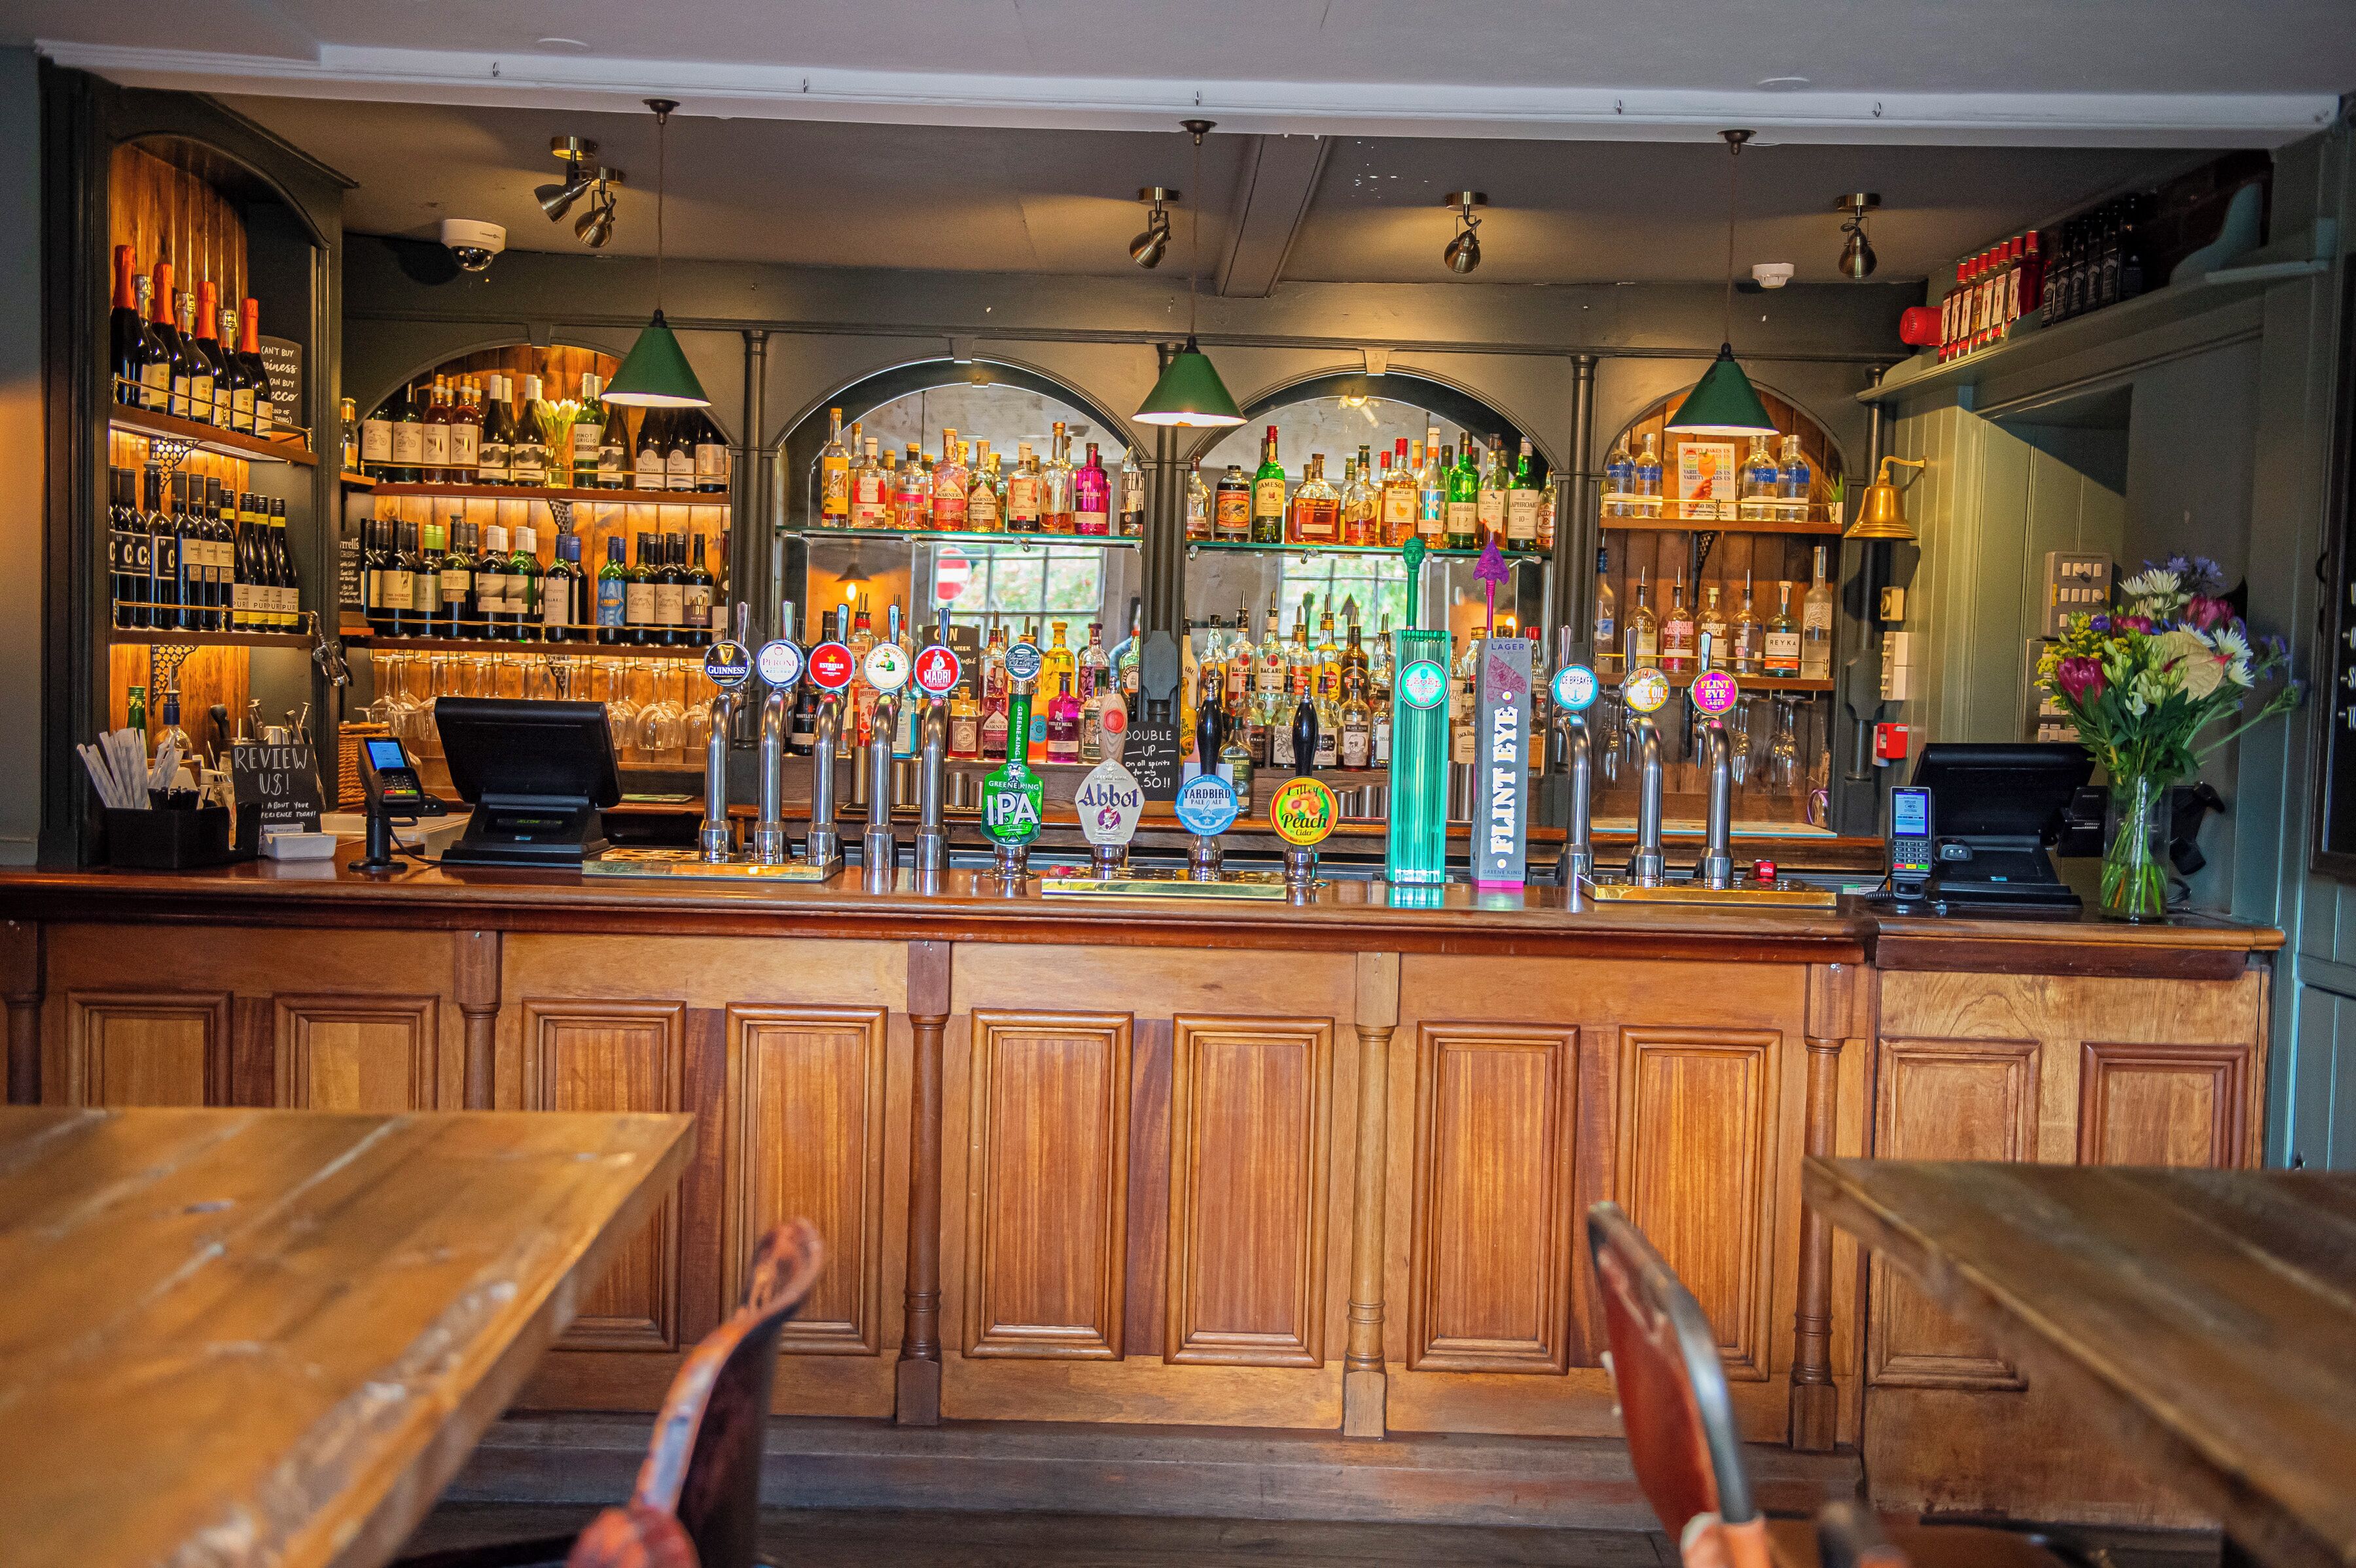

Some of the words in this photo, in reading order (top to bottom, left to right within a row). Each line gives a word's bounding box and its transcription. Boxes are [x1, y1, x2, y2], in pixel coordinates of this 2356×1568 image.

[261, 346, 279, 355] CAN'T
[707, 666, 746, 674] GUINNESS
[1406, 677, 1442, 688] LEVEL
[1569, 676, 1593, 685] BREAKER
[1701, 680, 1730, 689] FLINT
[1652, 687, 1664, 698] OIL
[1705, 689, 1726, 698] EYE
[1493, 706, 1518, 762] EYE
[1142, 745, 1156, 757] UP
[235, 747, 308, 772] REVIEW
[1149, 760, 1170, 769] spirits
[260, 774, 289, 795] US!
[1078, 783, 1139, 808] Abbot
[1184, 789, 1230, 799] YARDBIRD
[987, 793, 1039, 826] IPA
[1490, 767, 1516, 854] FLINT
[1281, 812, 1327, 829] Peach
